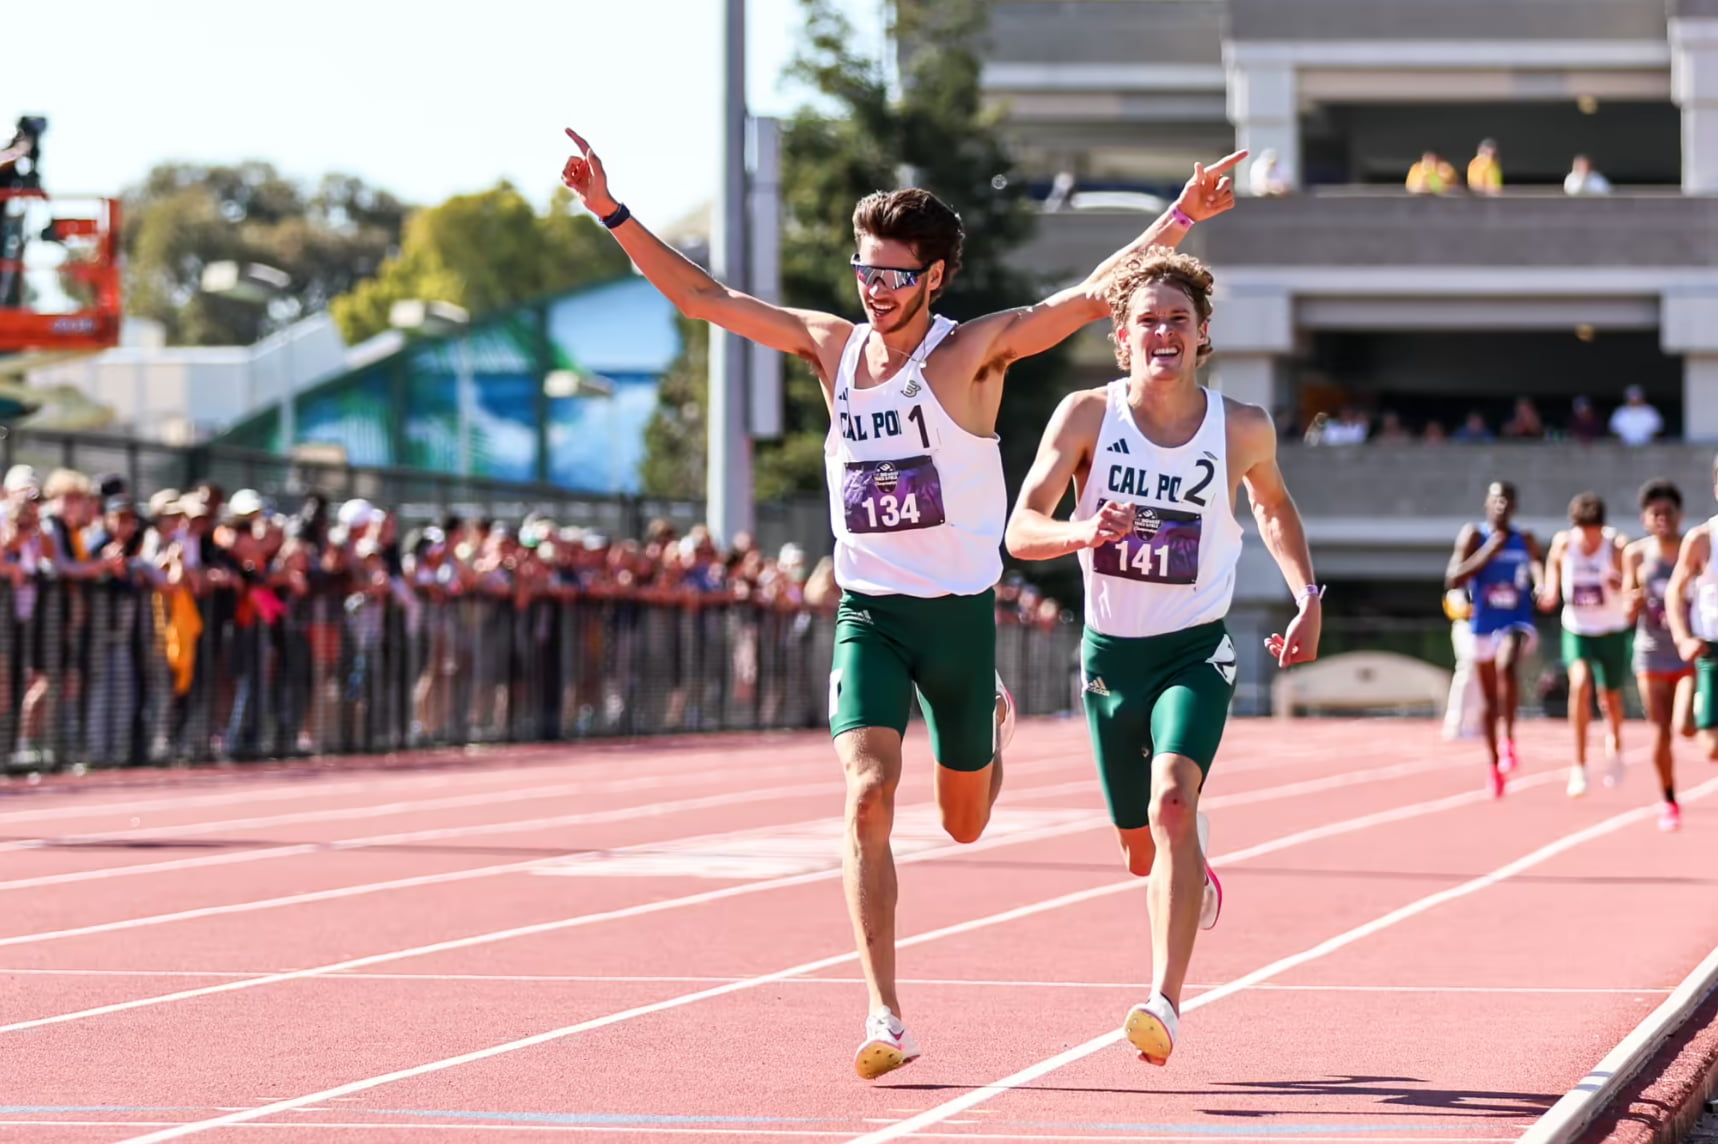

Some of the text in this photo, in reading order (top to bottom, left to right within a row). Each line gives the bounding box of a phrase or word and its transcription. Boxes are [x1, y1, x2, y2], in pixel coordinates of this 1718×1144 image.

[908, 404, 930, 448] 1
[1108, 464, 1149, 497] CAL
[1183, 459, 1215, 507] 2
[862, 494, 920, 527] 134
[1115, 540, 1169, 577] 141
